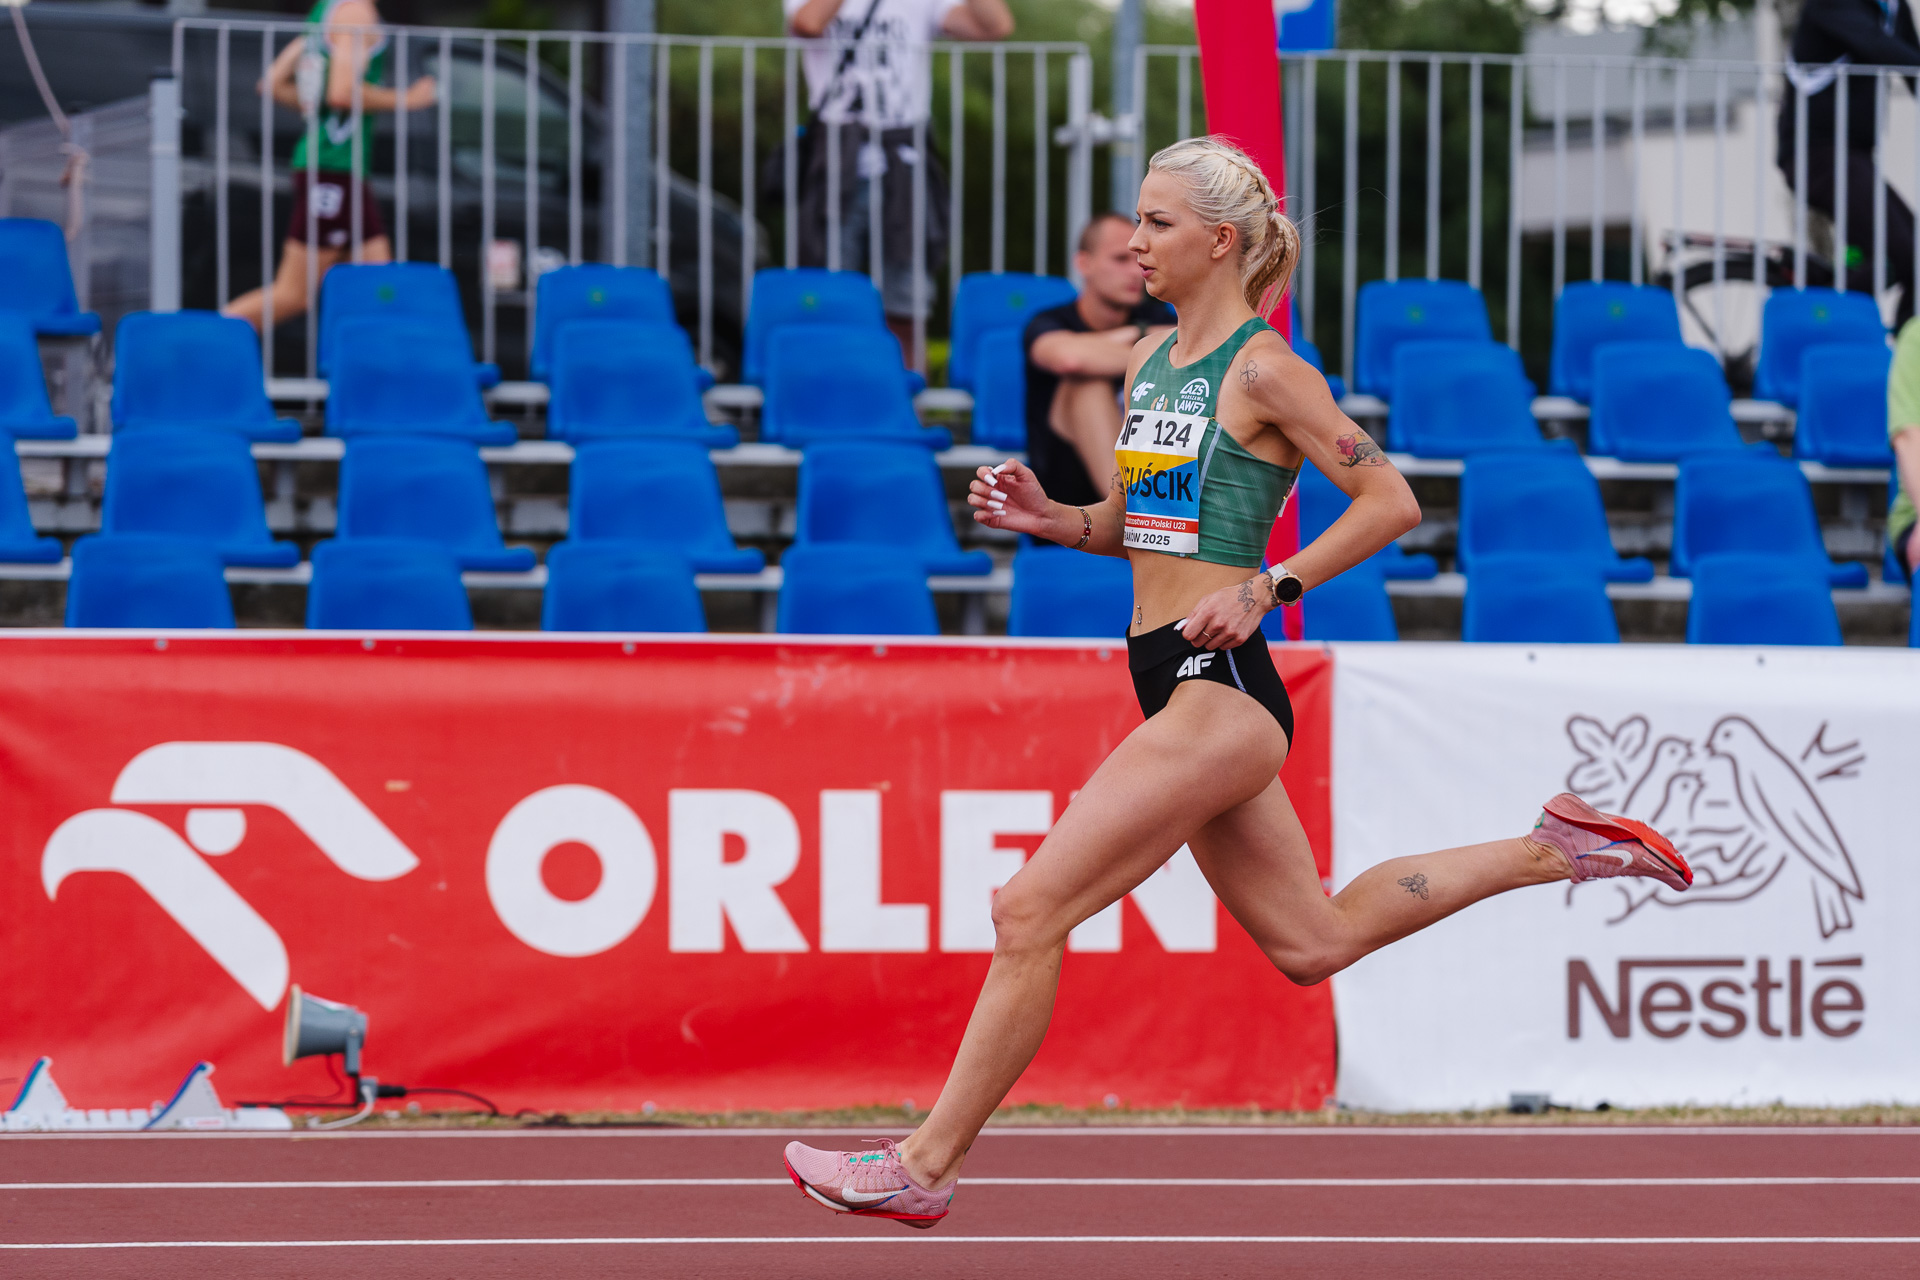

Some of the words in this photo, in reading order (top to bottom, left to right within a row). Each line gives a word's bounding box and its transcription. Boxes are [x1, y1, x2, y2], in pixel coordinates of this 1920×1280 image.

[1131, 381, 1156, 402] 4F
[1187, 384, 1205, 396] AZS
[1178, 399, 1200, 412] AWF
[1153, 419, 1193, 448] 124
[1150, 519, 1172, 529] Polski
[1173, 522, 1186, 530] U23
[1142, 533, 1170, 546] 2025
[1176, 652, 1216, 678] 4F
[1566, 956, 1866, 1040] Nestlé
